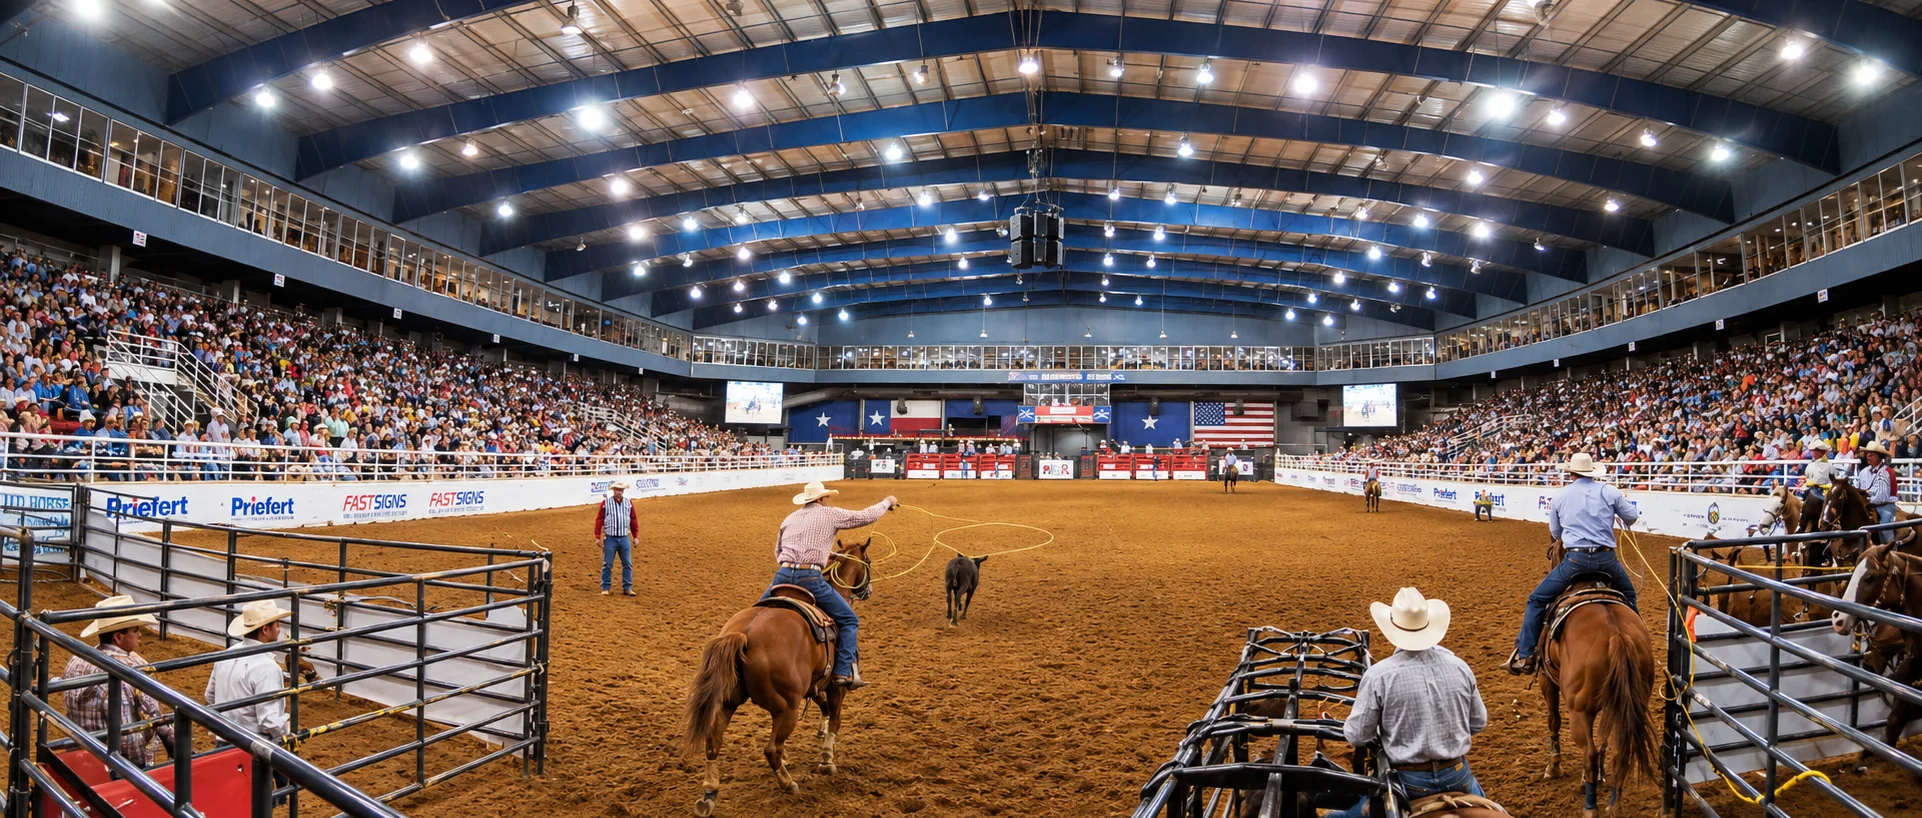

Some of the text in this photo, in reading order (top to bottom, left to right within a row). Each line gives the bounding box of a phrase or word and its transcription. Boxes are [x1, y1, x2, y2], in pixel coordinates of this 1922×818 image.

[106, 496, 188, 518] Priefert
[231, 496, 294, 516] Priefert
[342, 493, 408, 512] FASTSIGNS
[429, 490, 485, 507] FASTSIGNS
